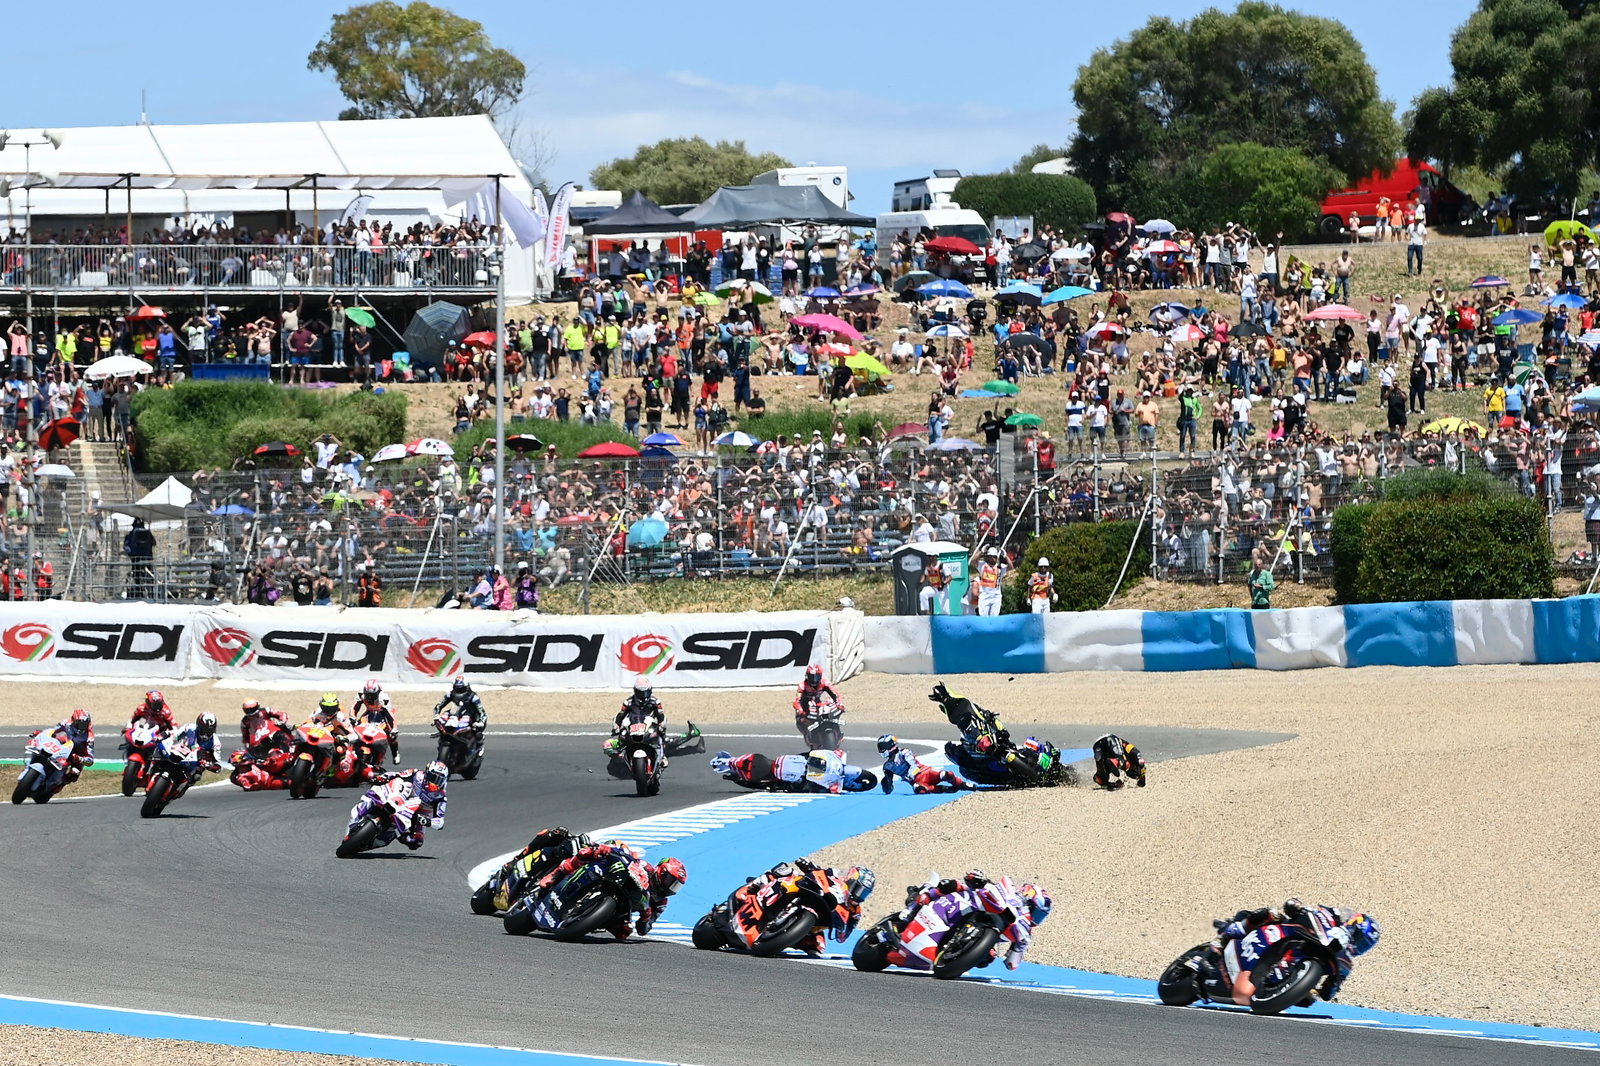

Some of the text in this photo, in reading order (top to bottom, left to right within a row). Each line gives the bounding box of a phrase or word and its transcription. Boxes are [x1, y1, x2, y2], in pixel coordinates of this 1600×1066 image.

[56, 623, 184, 661] SIDI
[258, 631, 390, 671] SIDI
[464, 634, 604, 673] SIDI
[676, 629, 817, 669] SIDI
[43, 741, 62, 754] 49
